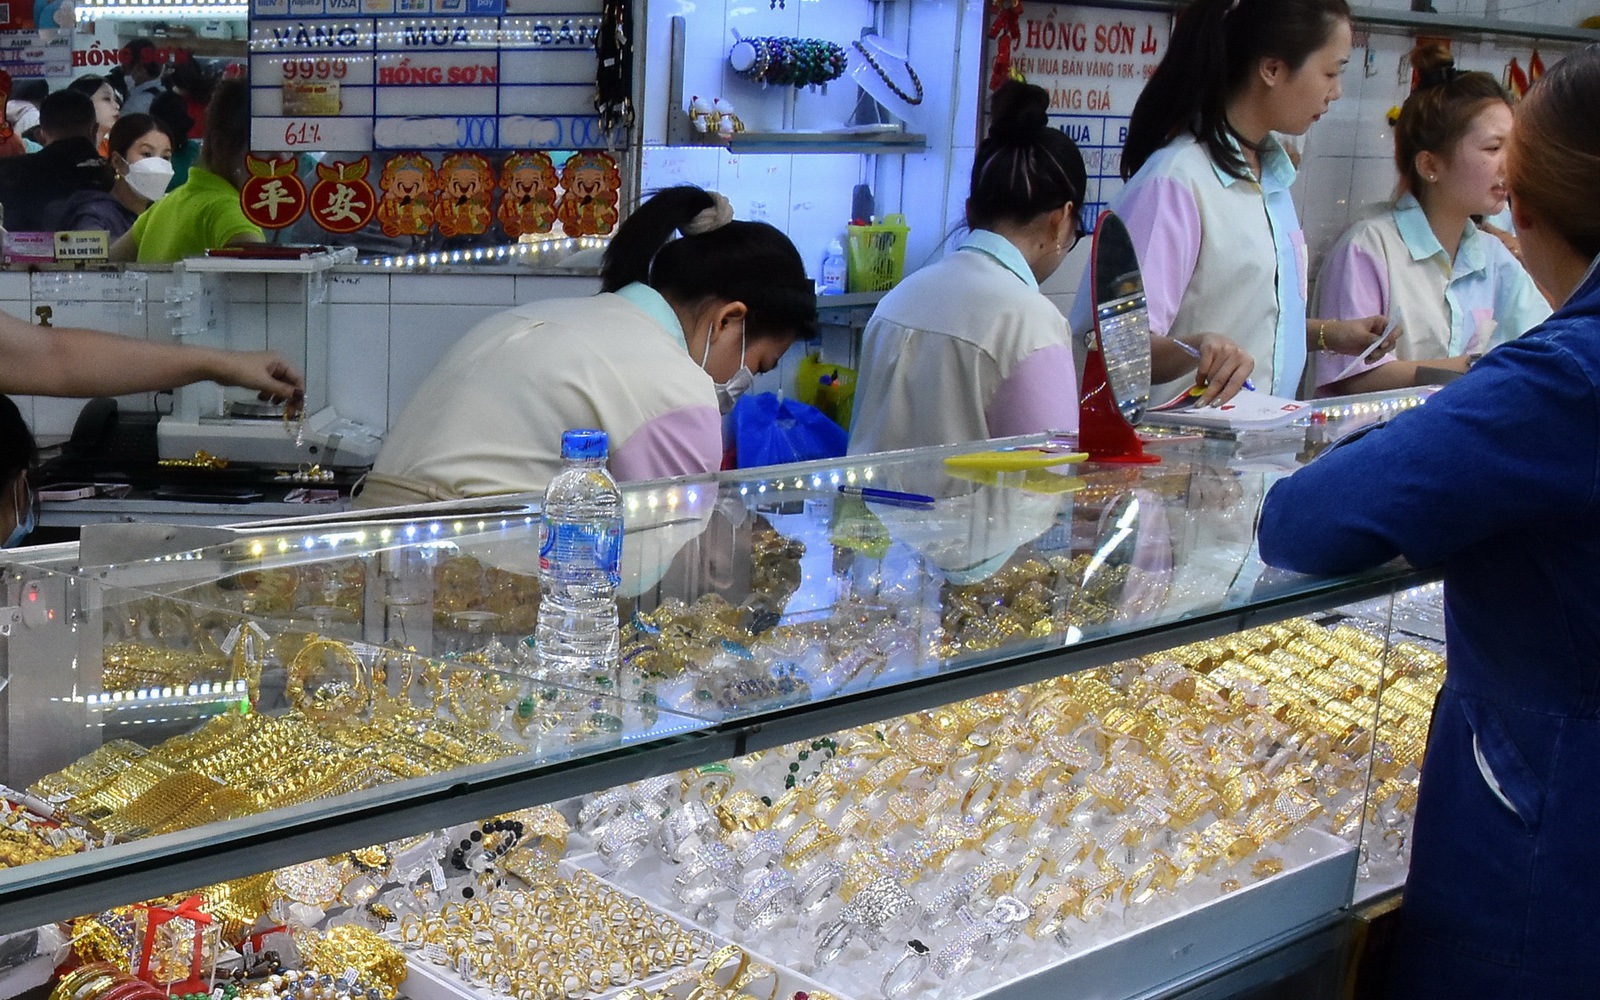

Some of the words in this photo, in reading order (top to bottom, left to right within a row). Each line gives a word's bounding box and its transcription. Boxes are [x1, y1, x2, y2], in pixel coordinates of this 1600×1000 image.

[405, 26, 469, 46] MUA
[1025, 8, 1087, 52] HỒNG
[1094, 21, 1136, 54] SƠN
[283, 59, 347, 79] 9999
[447, 64, 497, 84] SƠN
[1038, 57, 1059, 75] MUA
[1062, 56, 1083, 76] BÁN
[1118, 63, 1134, 79] 18K
[1048, 80, 1082, 110] ẢNG
[1086, 84, 1111, 111] GIÁ
[284, 122, 322, 146] 61%
[1060, 124, 1091, 143] MUA
[251, 179, 296, 221] 平
[320, 183, 367, 224] 安
